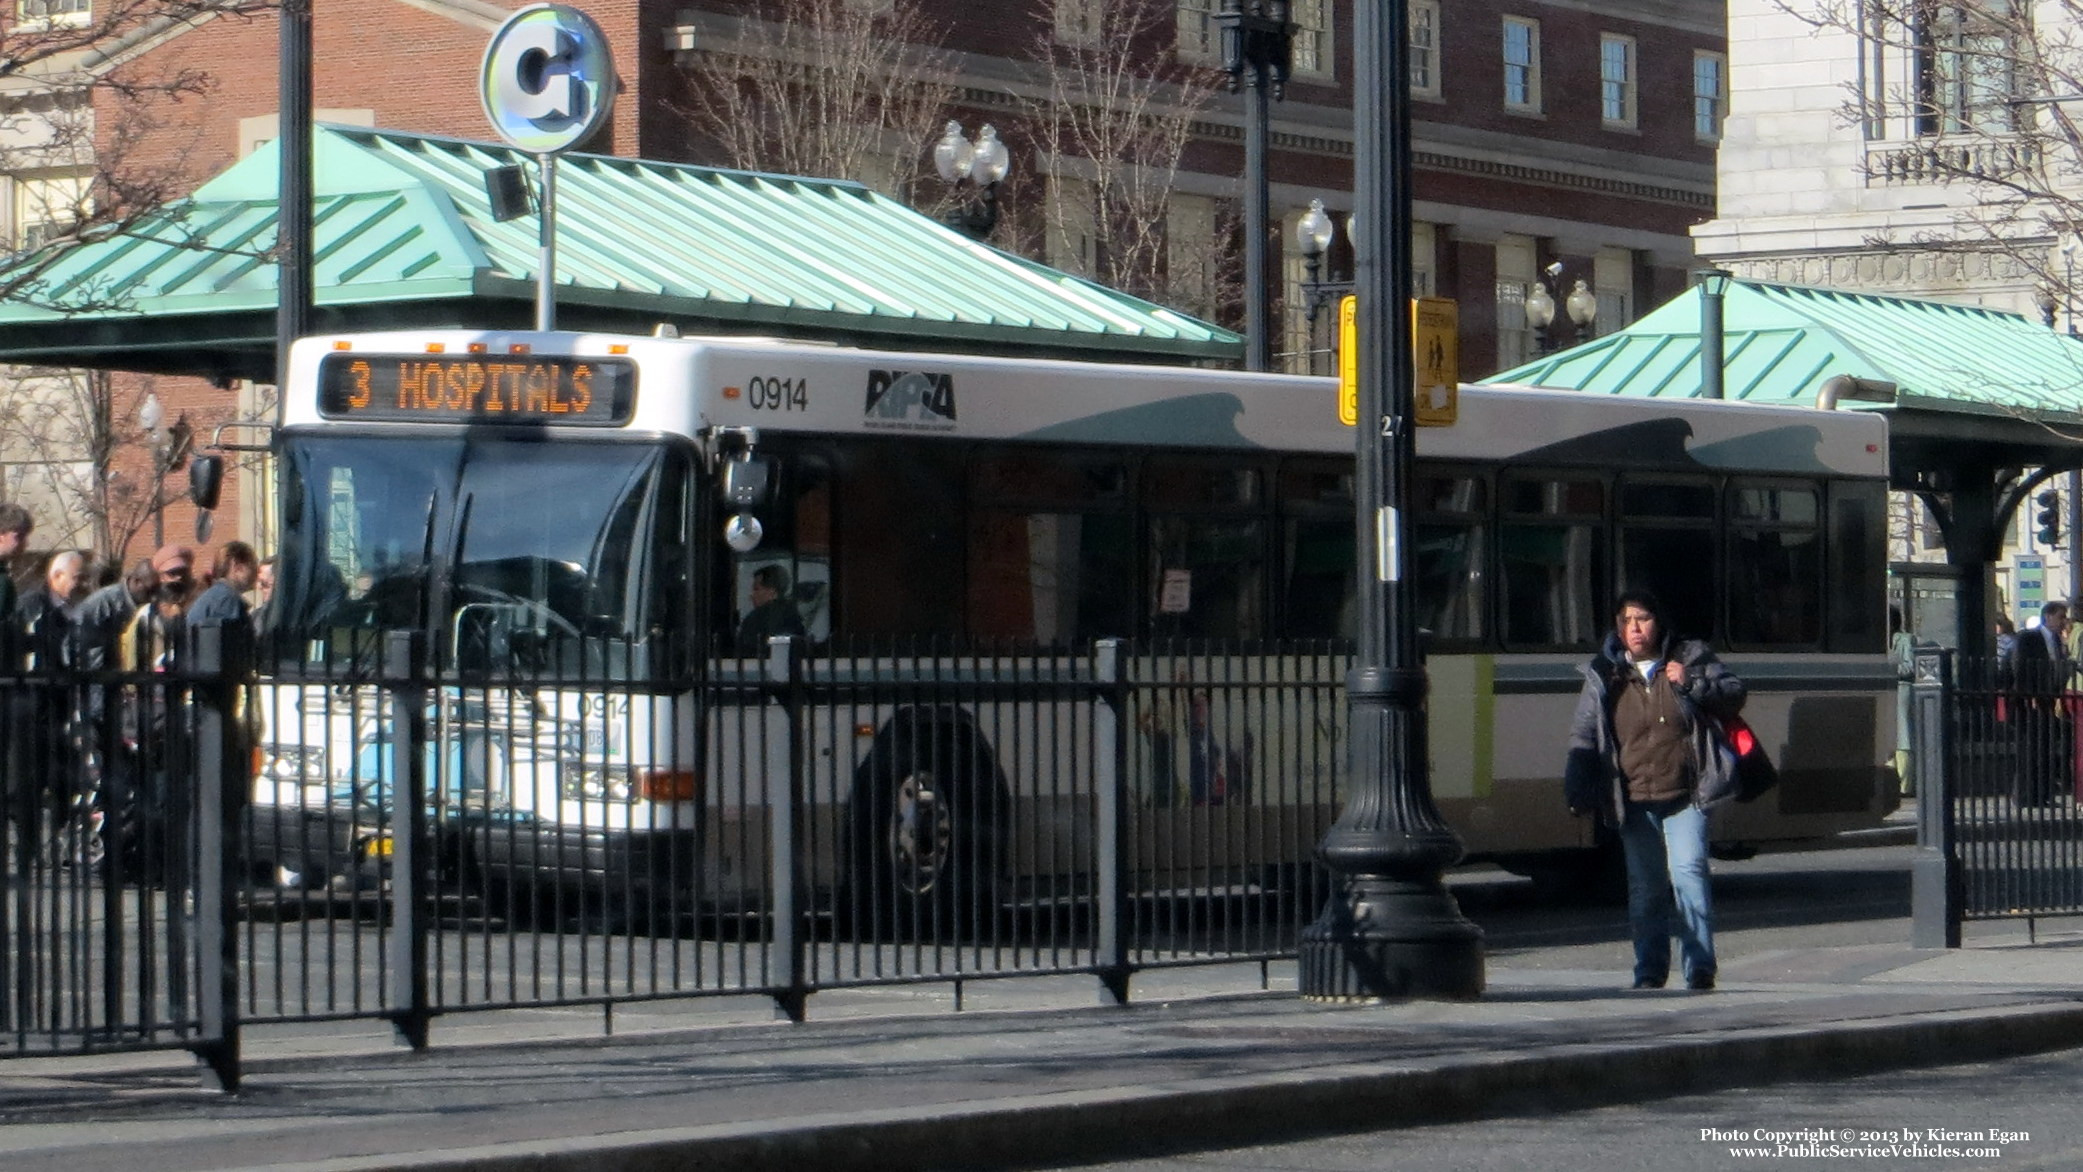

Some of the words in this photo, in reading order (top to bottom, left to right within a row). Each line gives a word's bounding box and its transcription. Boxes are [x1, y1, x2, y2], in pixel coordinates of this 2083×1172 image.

[350, 361, 371, 408] 3
[399, 361, 592, 413] HOSPITALS
[749, 376, 808, 411] 0914
